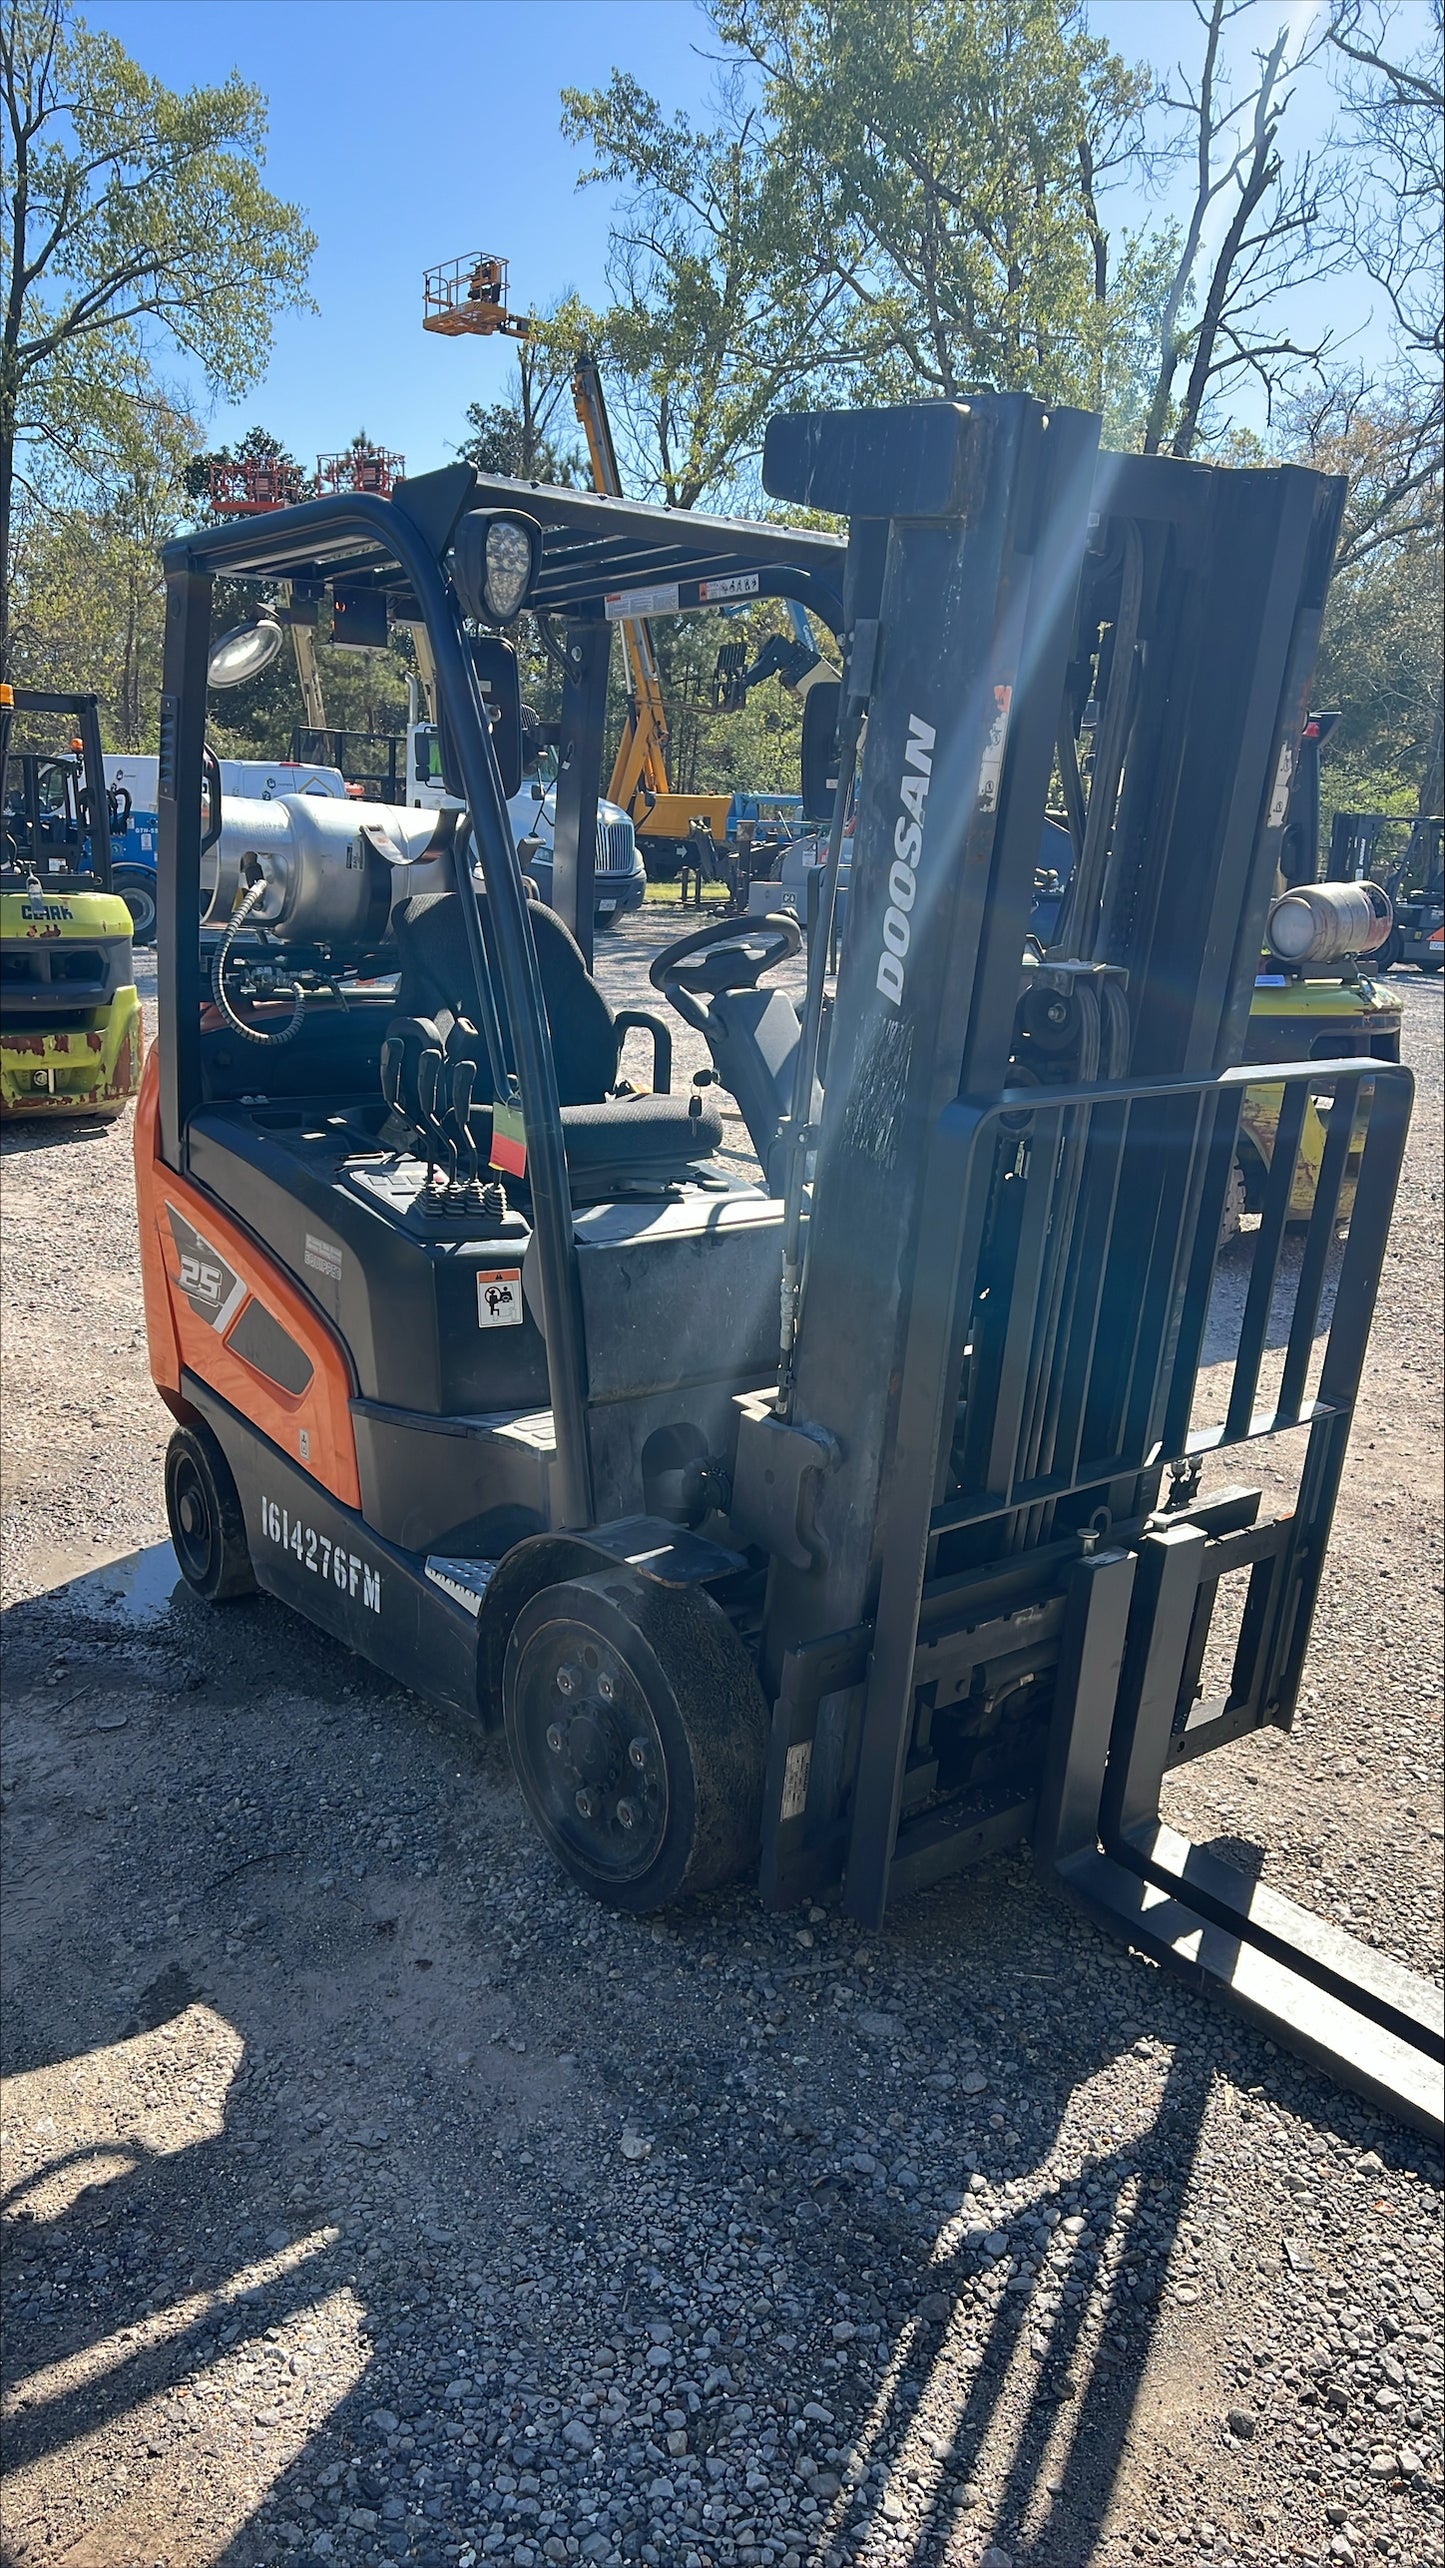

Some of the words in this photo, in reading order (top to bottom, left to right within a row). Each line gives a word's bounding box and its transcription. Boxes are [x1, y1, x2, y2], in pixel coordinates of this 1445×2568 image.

[876, 713, 936, 1006] DOOSAN
[179, 1254, 223, 1306] 25
[262, 1495, 380, 1614] 1614276FM
